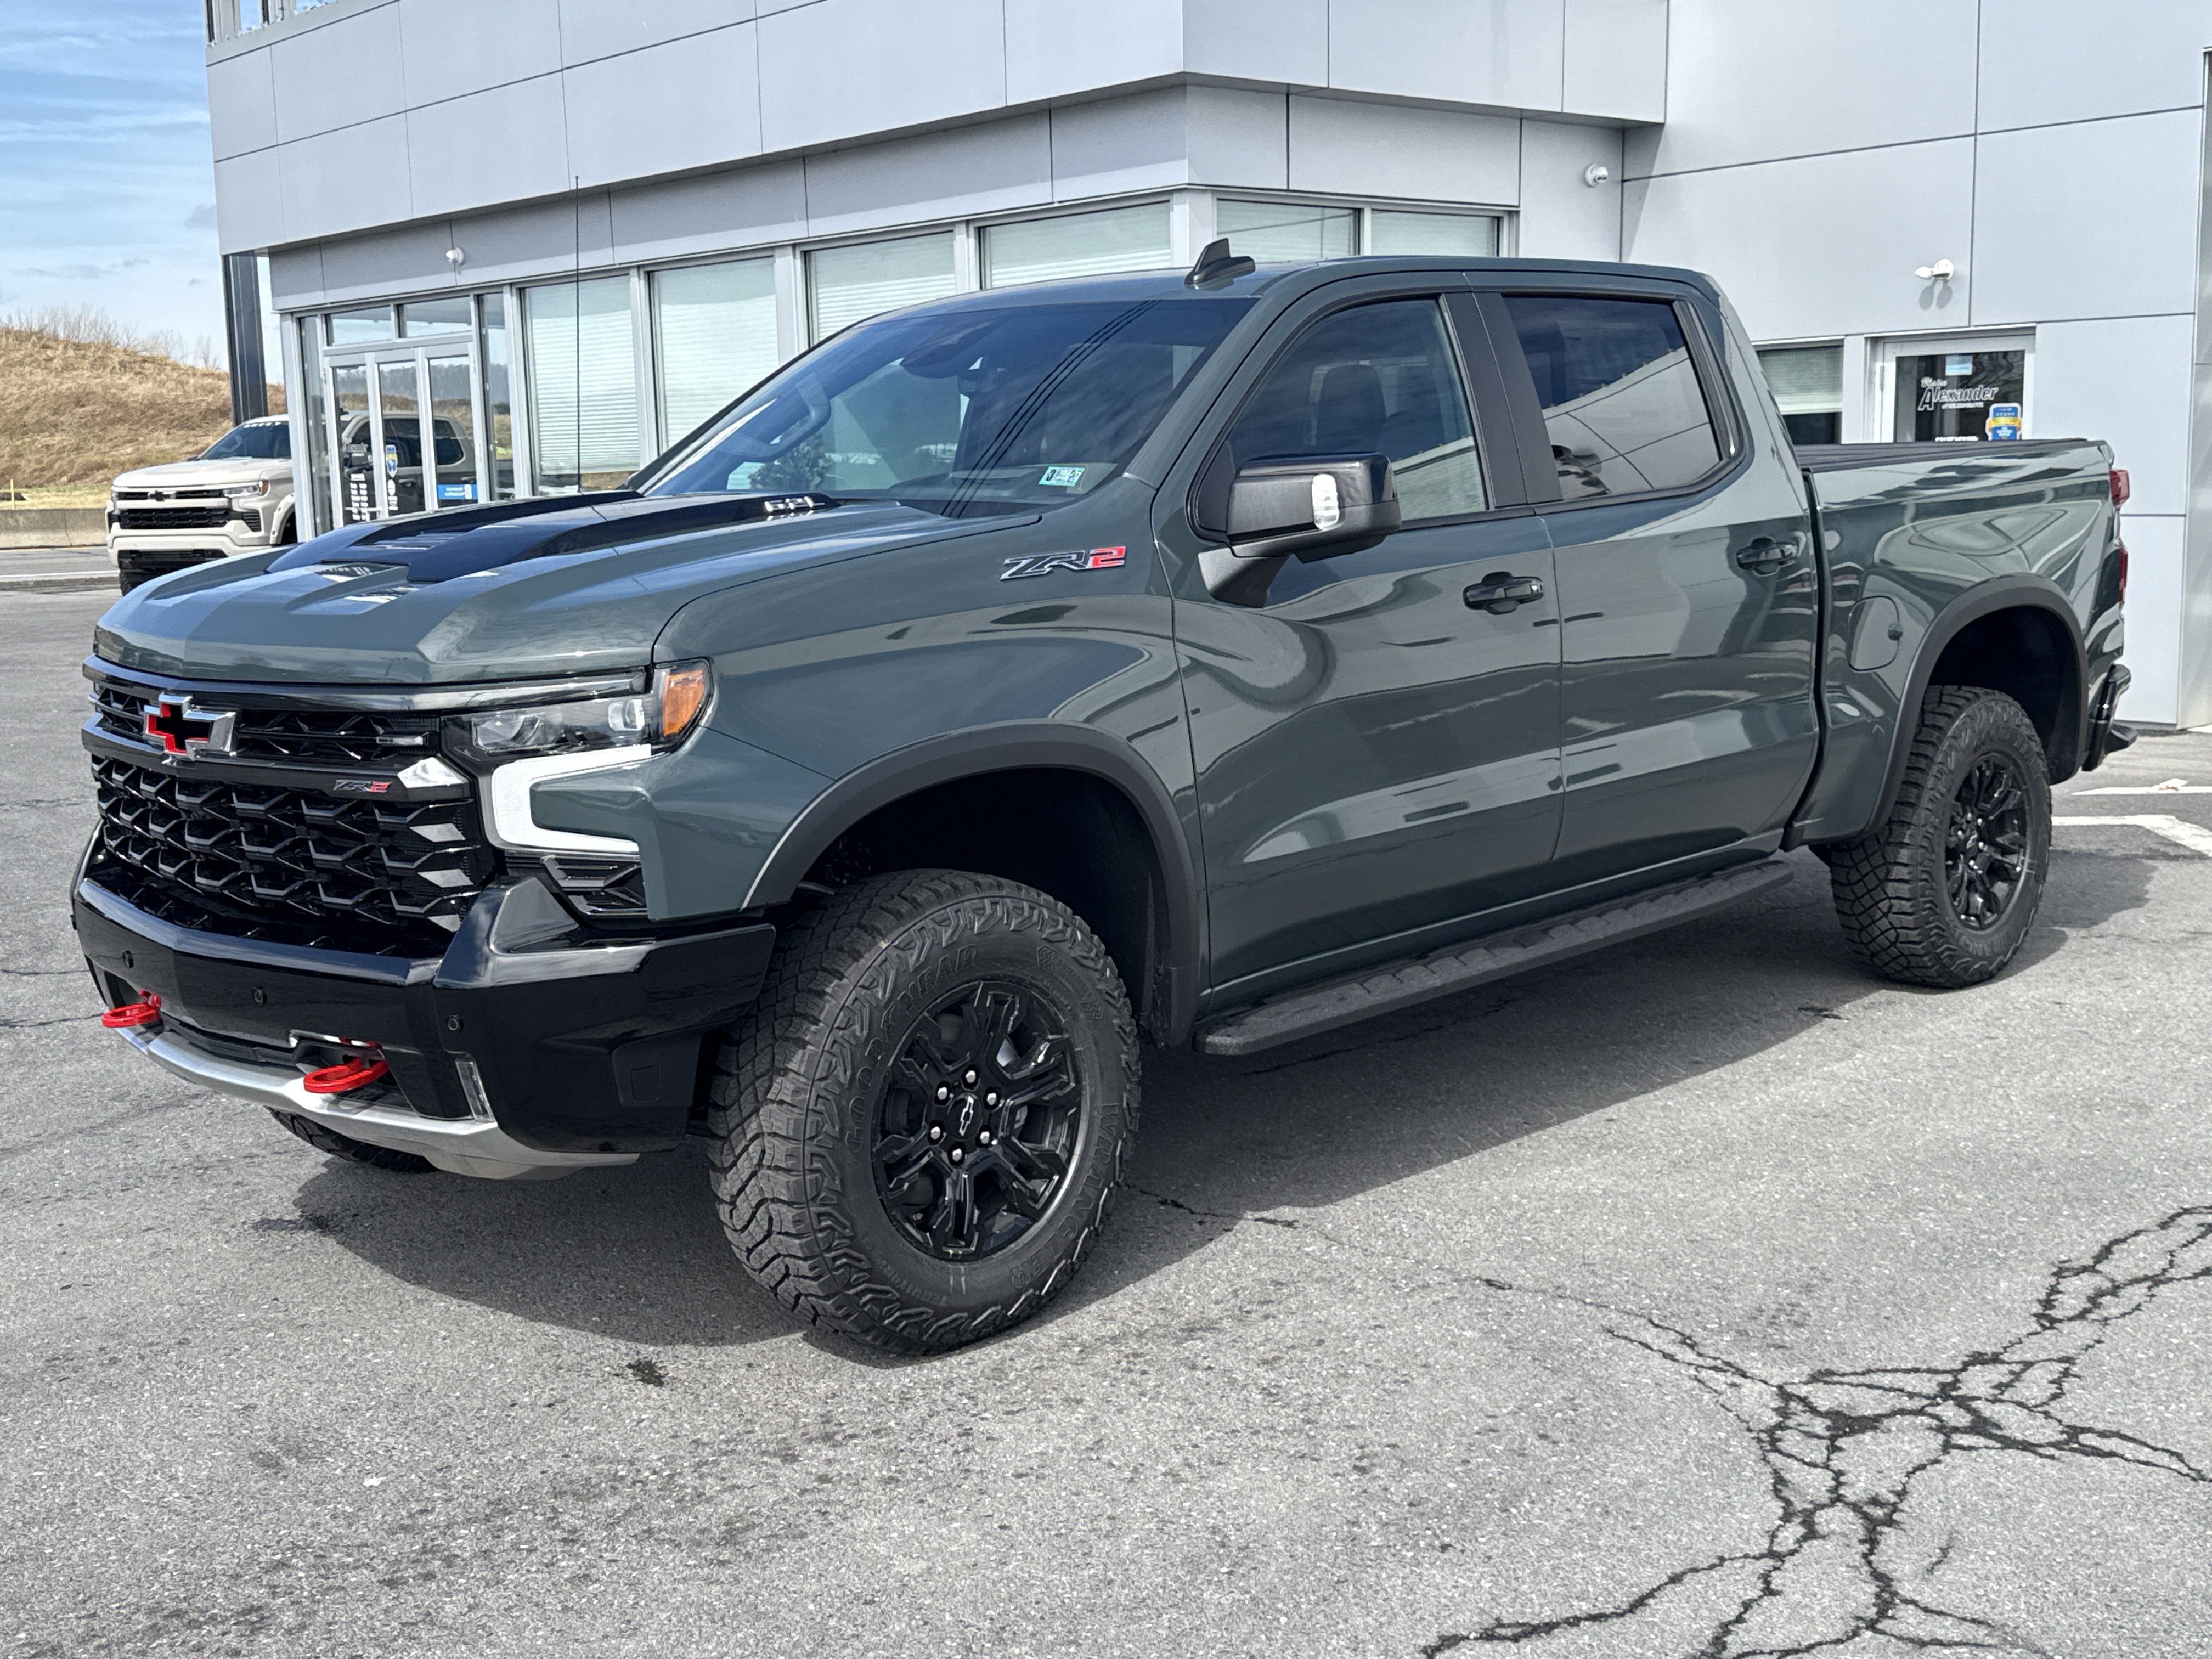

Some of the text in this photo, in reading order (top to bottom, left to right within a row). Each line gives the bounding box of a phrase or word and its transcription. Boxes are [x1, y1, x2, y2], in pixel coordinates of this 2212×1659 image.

[1917, 385, 1999, 411] Alexander
[1046, 469, 1056, 481] 3
[1000, 546, 1126, 580] ZR2
[332, 779, 393, 793] ZR2
[1011, 1102, 1119, 1289] WRANGLER
